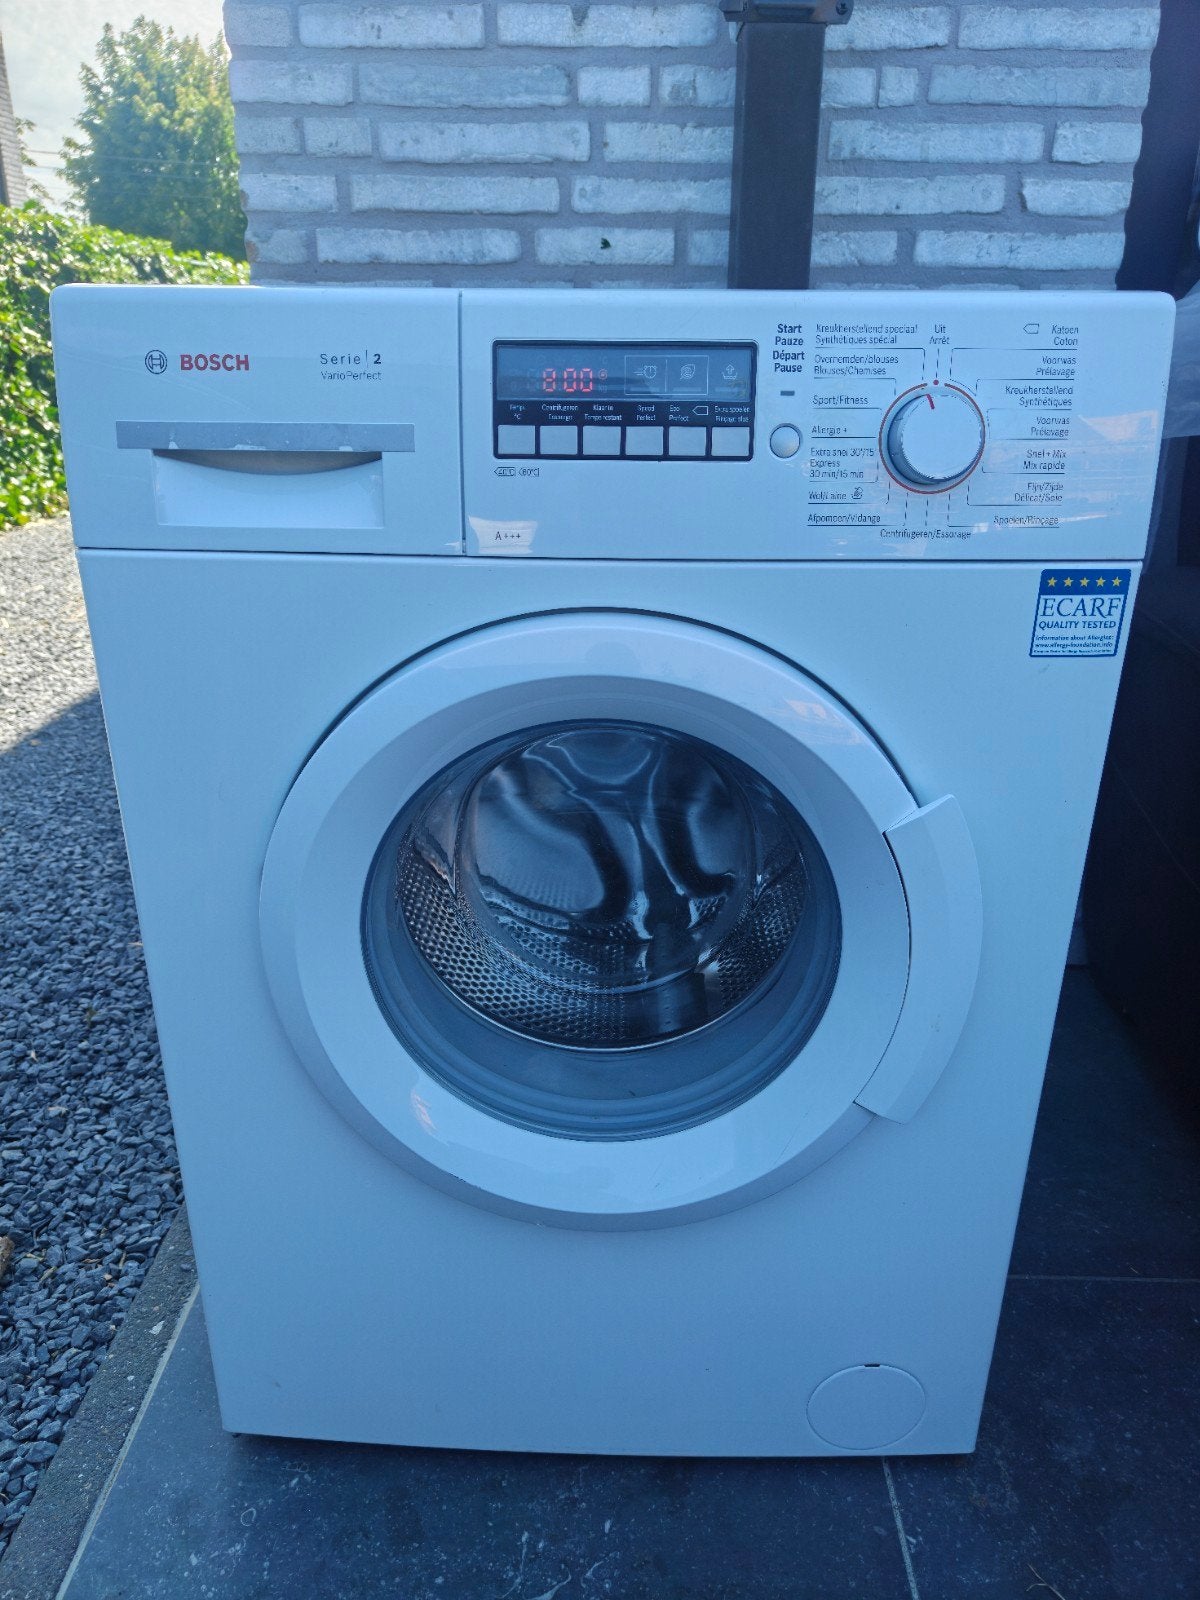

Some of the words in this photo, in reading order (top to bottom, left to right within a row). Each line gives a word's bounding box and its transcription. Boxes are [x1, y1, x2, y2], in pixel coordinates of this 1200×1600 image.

[777, 323, 802, 333] Start
[934, 324, 946, 333] Uit
[1051, 324, 1079, 334] Katoen
[775, 336, 804, 346] Pauze
[815, 335, 868, 346] Synthétiques
[869, 335, 897, 346] spécial
[929, 335, 951, 345] Arrêt
[1053, 336, 1078, 346] Coton
[320, 353, 361, 365] Serie
[373, 353, 382, 364] 2
[773, 349, 805, 362] Départ
[1042, 355, 1077, 365] Voorwas
[180, 354, 250, 371] BOSCH
[774, 362, 803, 373] Pause
[320, 370, 382, 381] VarioPerfect
[814, 366, 887, 377] Blouses/Chemises
[1036, 367, 1075, 378] Prélavage
[1005, 385, 1074, 395] Kreukherstellend
[812, 395, 869, 407] Sport/Fitness
[1019, 396, 1072, 408] Synthétiques
[1037, 416, 1070, 425] Voorwas
[1030, 427, 1069, 438] Prélavage
[810, 447, 832, 457] Extra
[1026, 449, 1045, 459] Snel
[1052, 449, 1067, 459] Mix
[809, 459, 841, 469] Express
[1022, 460, 1037, 470] Mix
[1039, 460, 1066, 472] rapide
[809, 470, 820, 478] 30
[879, 528, 972, 540] Centrifugeren/Essorage
[1040, 597, 1121, 618] ECARF
[1038, 620, 1080, 631] QUALITY
[1081, 620, 1117, 629] TESTED
